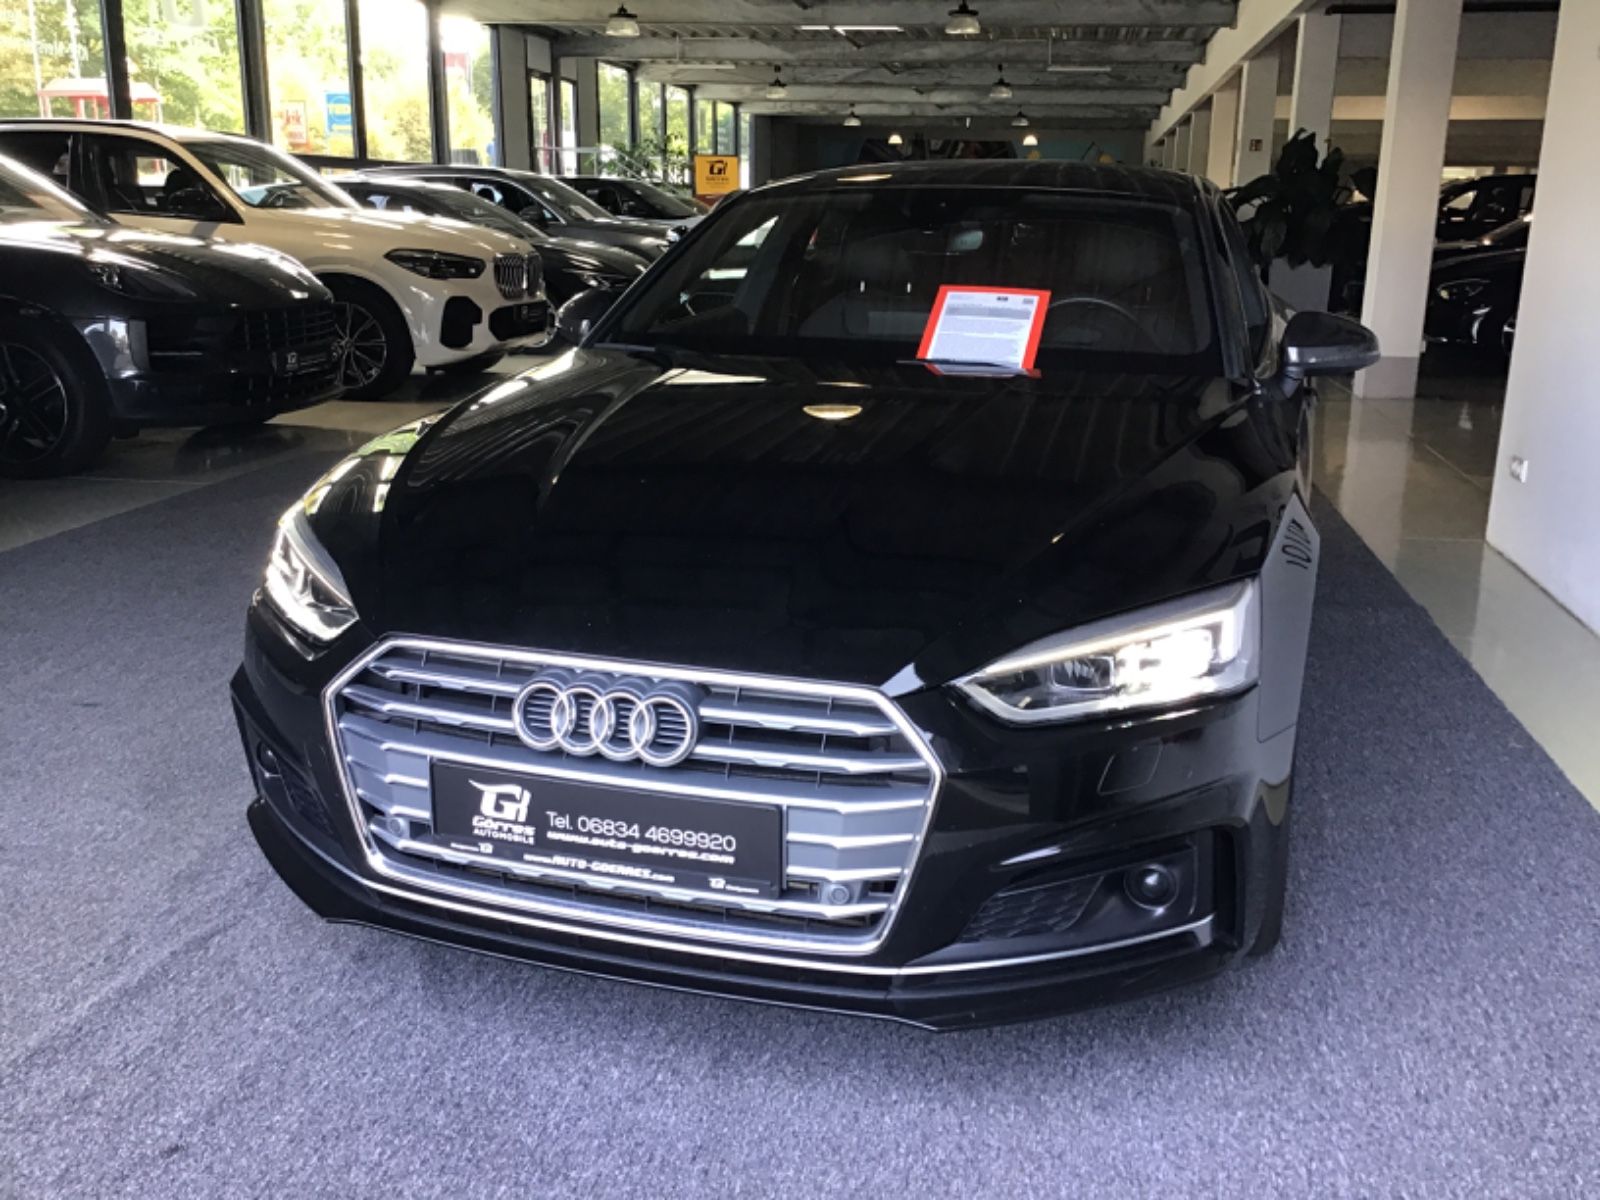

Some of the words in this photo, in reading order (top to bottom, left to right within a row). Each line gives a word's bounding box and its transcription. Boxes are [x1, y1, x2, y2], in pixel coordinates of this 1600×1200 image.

[473, 828, 534, 846] AUTOMOBILE
[546, 811, 573, 830] Tel.
[578, 816, 640, 839] 06834
[645, 826, 736, 852] 4699920
